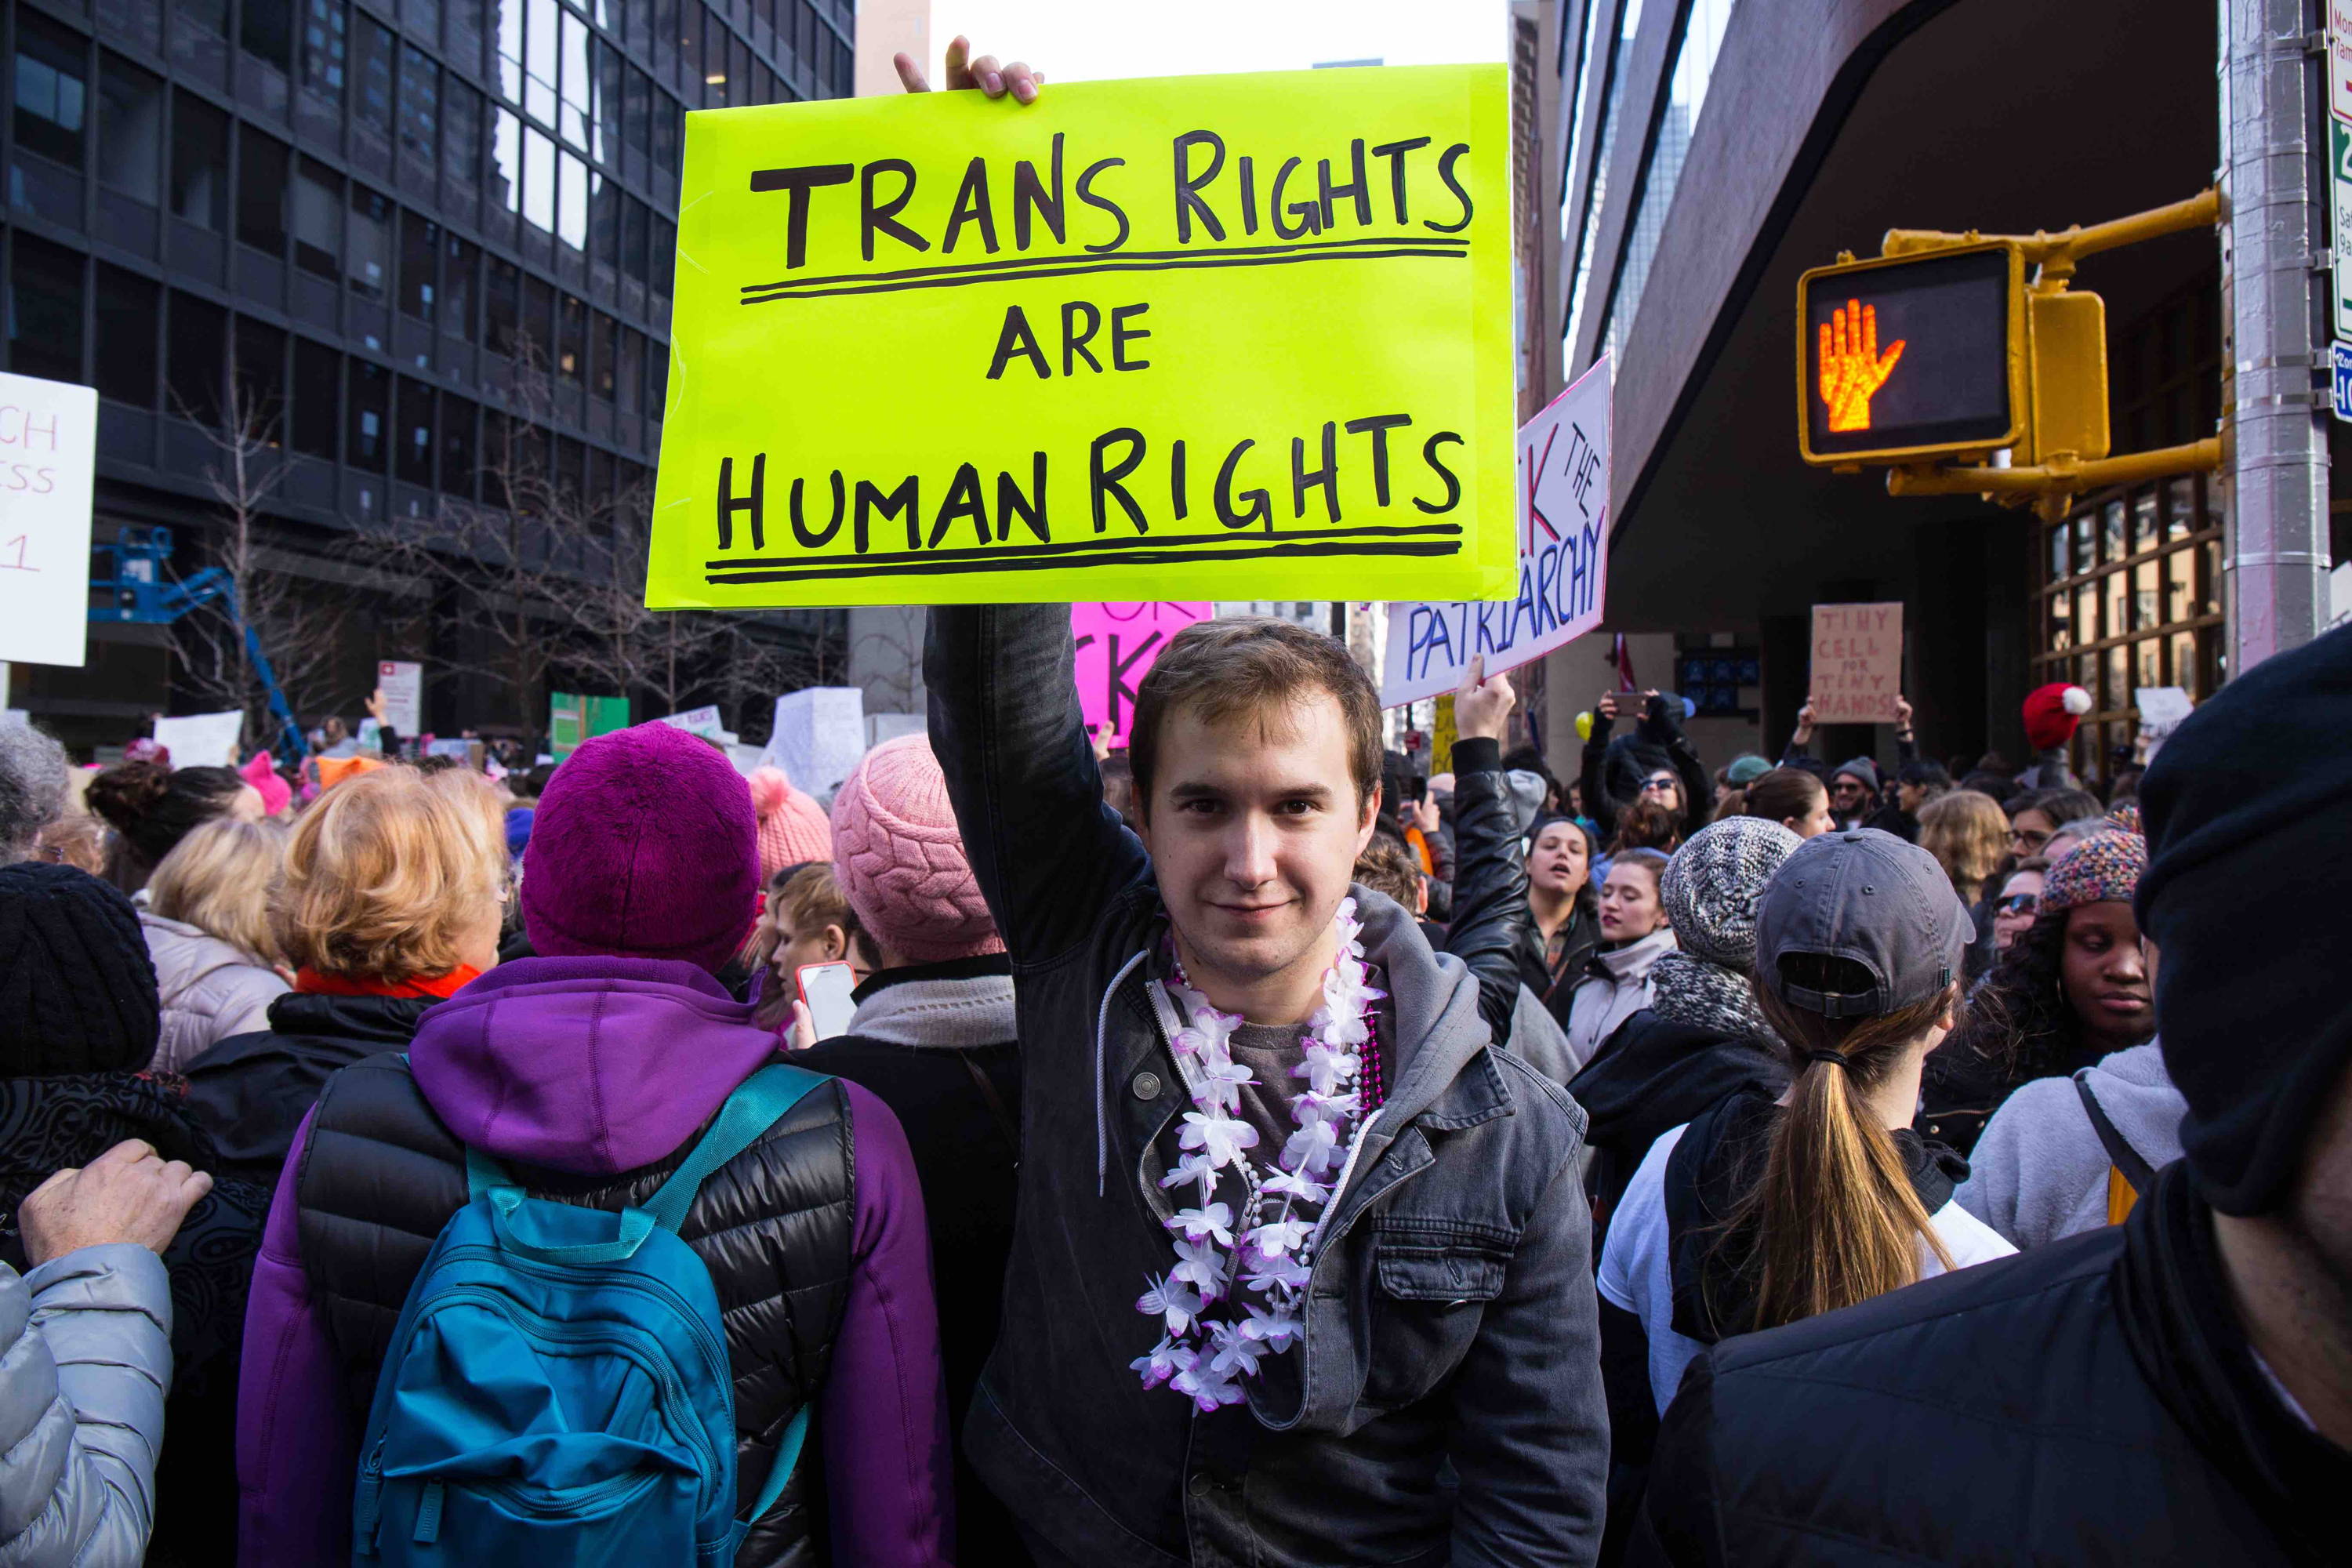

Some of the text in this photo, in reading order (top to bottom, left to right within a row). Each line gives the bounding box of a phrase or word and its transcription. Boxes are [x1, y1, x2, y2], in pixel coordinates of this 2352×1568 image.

[750, 130, 1473, 269] TRANS RIGHTS
[985, 301, 1151, 380] ARE
[717, 414, 1465, 554] HUMAN RIGHTS
[1519, 421, 1600, 558] K THE
[1406, 506, 1606, 682] PATRIARCHY
[1820, 609, 1889, 630] TINY
[1817, 674, 1885, 691] TINY
[1818, 637, 1880, 659] CELL
[1843, 659, 1869, 673] FOR
